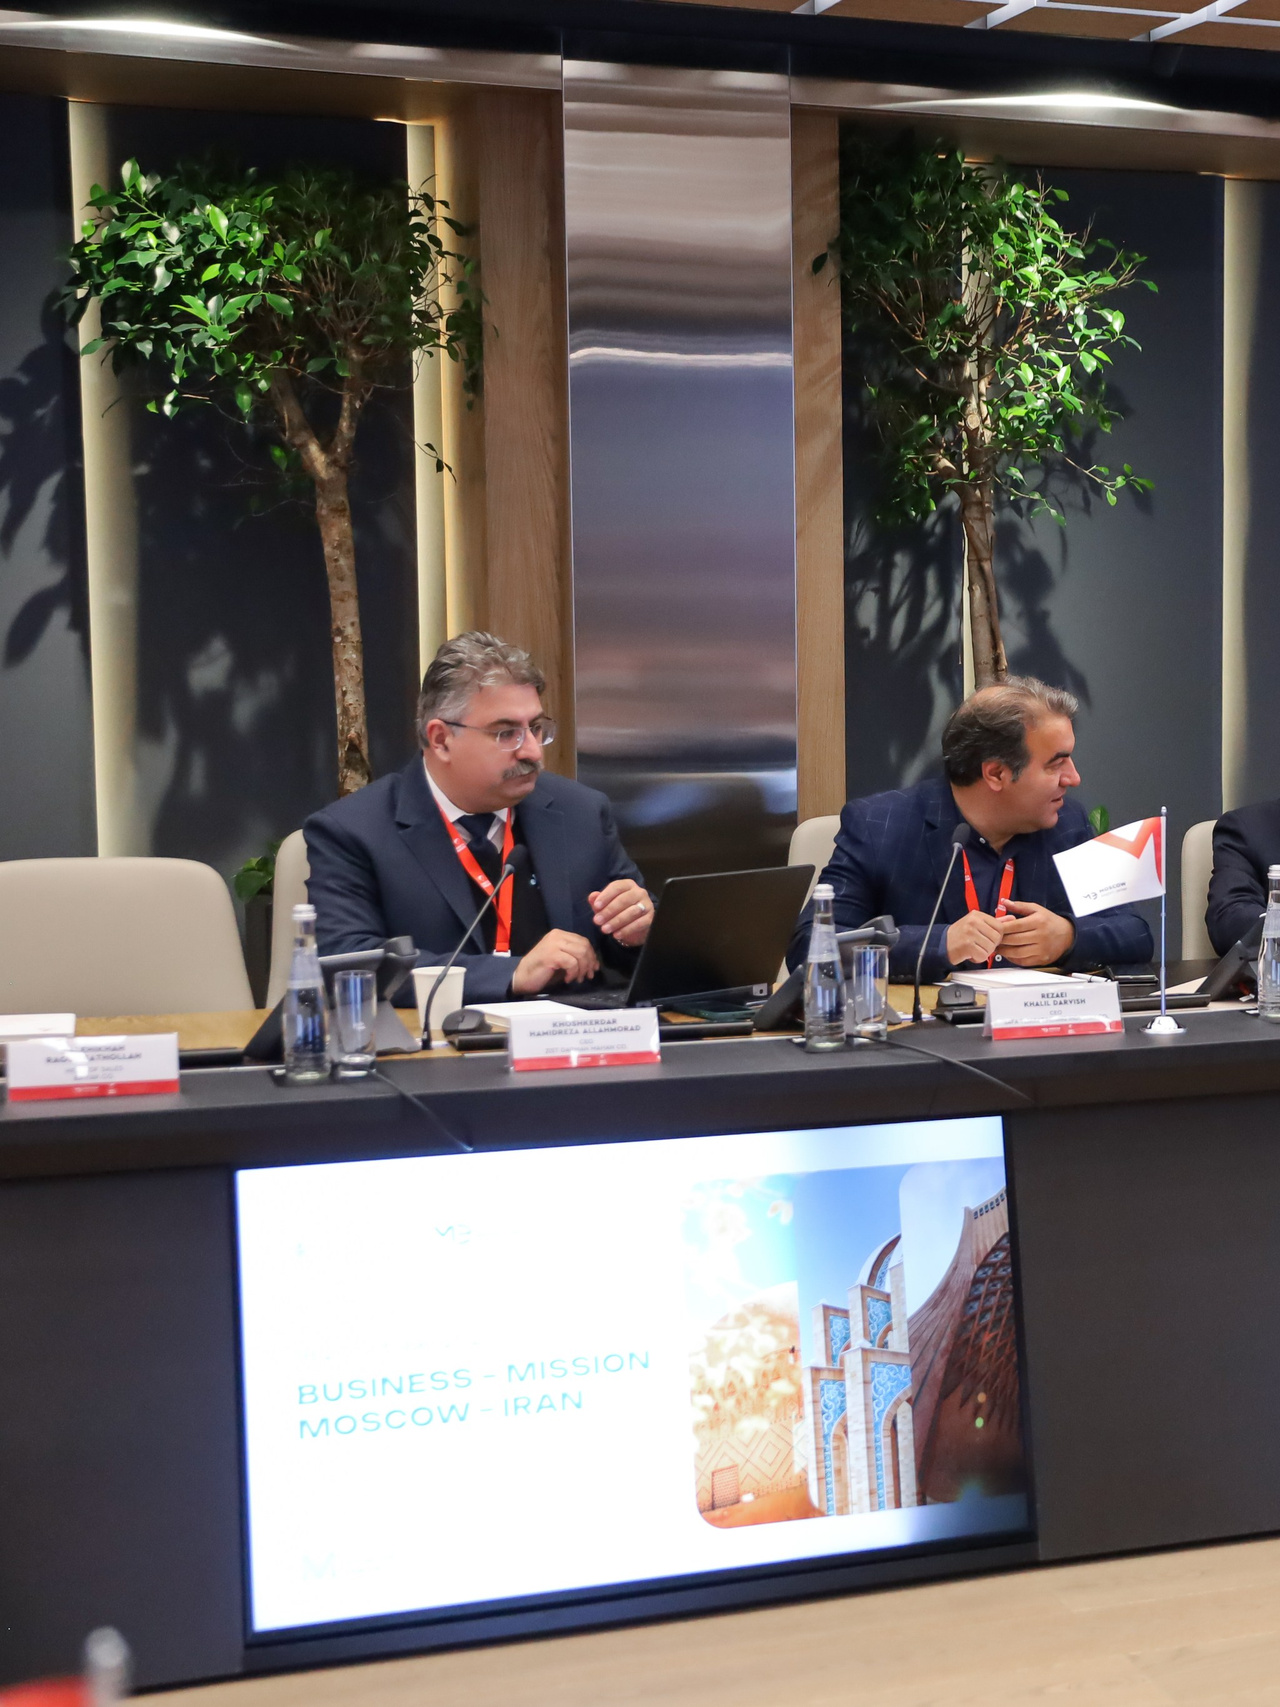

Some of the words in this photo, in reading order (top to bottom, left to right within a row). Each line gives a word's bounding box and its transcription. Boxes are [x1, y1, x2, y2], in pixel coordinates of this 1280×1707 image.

[1099, 882, 1127, 893] MOSCOW
[553, 1019, 617, 1028] KHOSHKERDAR
[530, 1028, 579, 1037] HAMIDREZA
[297, 1370, 473, 1405] BUSINESS
[508, 1351, 650, 1384] MISSION
[299, 1402, 470, 1439] MOSCOW
[503, 1391, 583, 1417] IRAN
